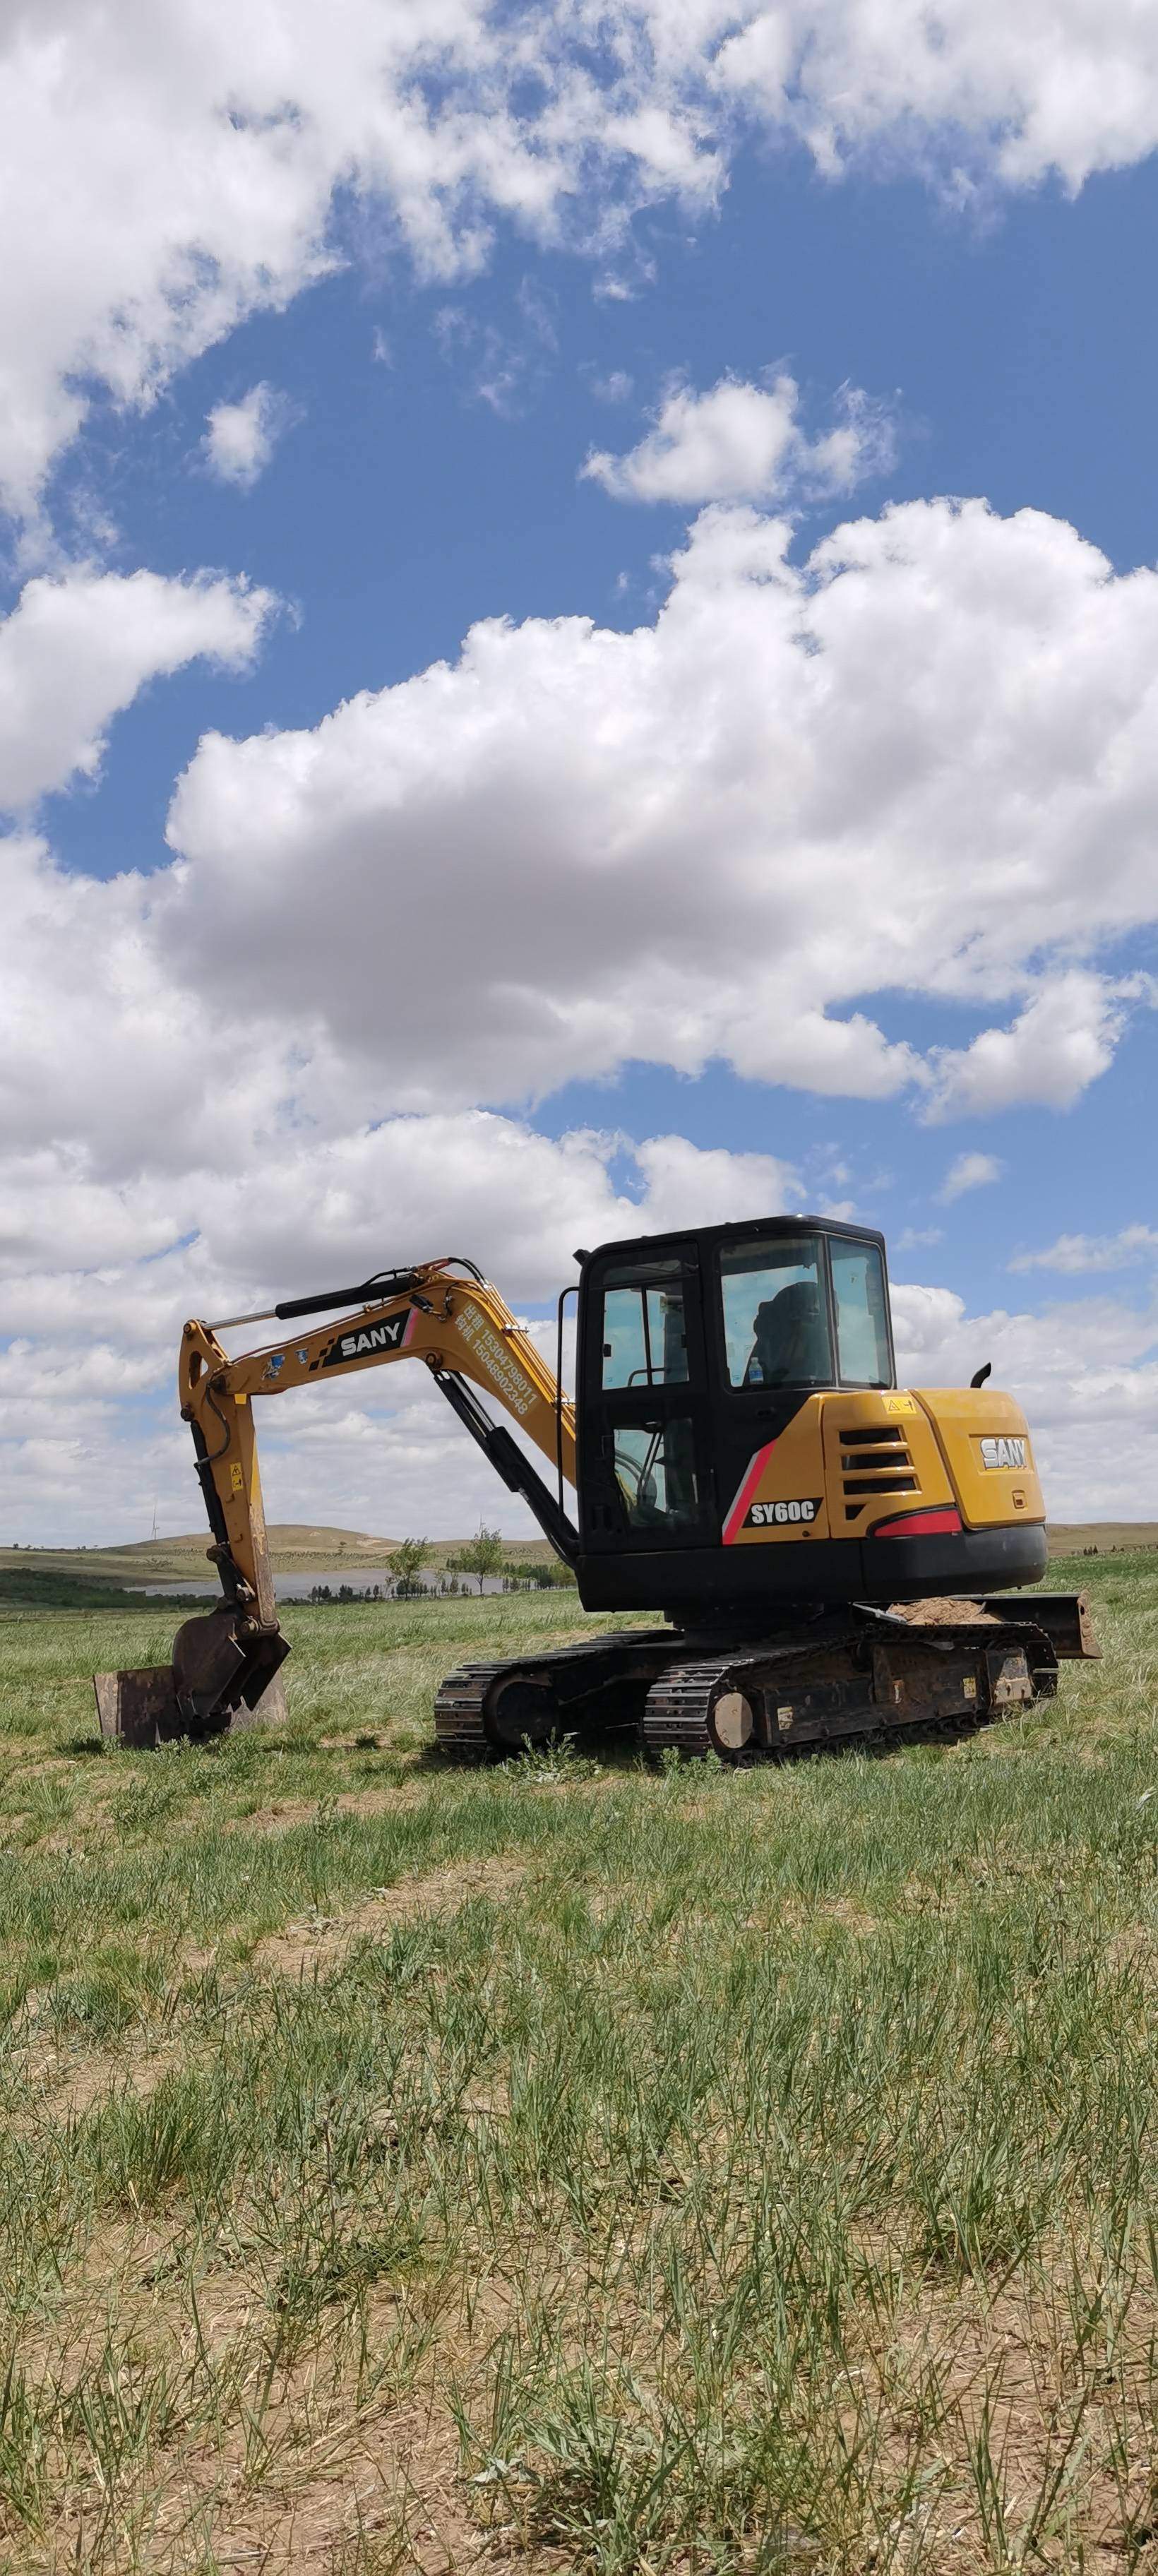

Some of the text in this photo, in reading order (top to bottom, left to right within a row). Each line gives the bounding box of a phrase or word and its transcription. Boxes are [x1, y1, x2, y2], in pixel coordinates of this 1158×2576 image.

[340, 1322, 400, 1356] SANY
[464, 1305, 537, 1404] 出租 15304798011
[472, 1340, 528, 1415] 15048902348
[751, 1501, 815, 1524] SY60C
